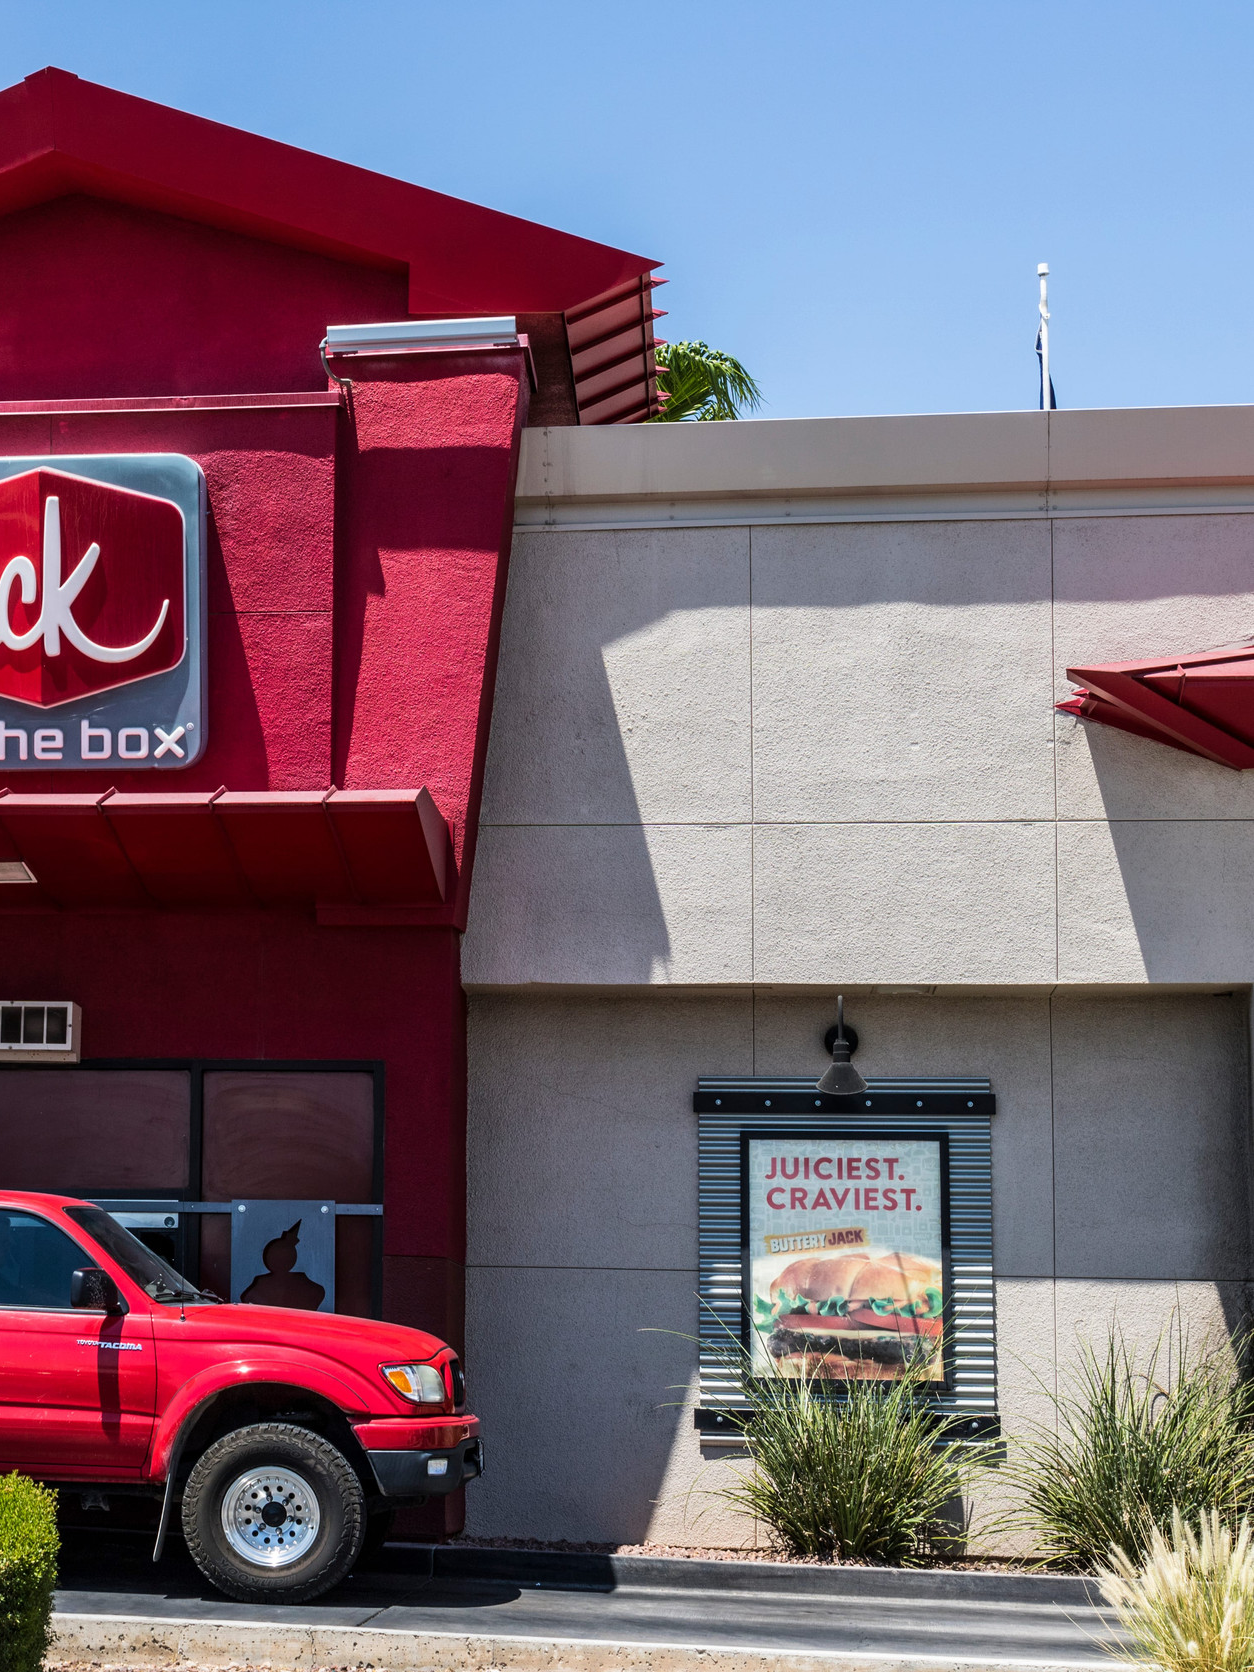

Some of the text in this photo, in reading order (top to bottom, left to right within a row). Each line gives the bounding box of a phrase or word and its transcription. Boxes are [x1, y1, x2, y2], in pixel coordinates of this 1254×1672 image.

[81, 719, 185, 760] box
[765, 1157, 905, 1180] JUICIEST.
[766, 1187, 922, 1211] CRAVIEST.
[771, 1228, 864, 1253] BUTTERY JACK
[98, 1341, 143, 1351] TACOMA
